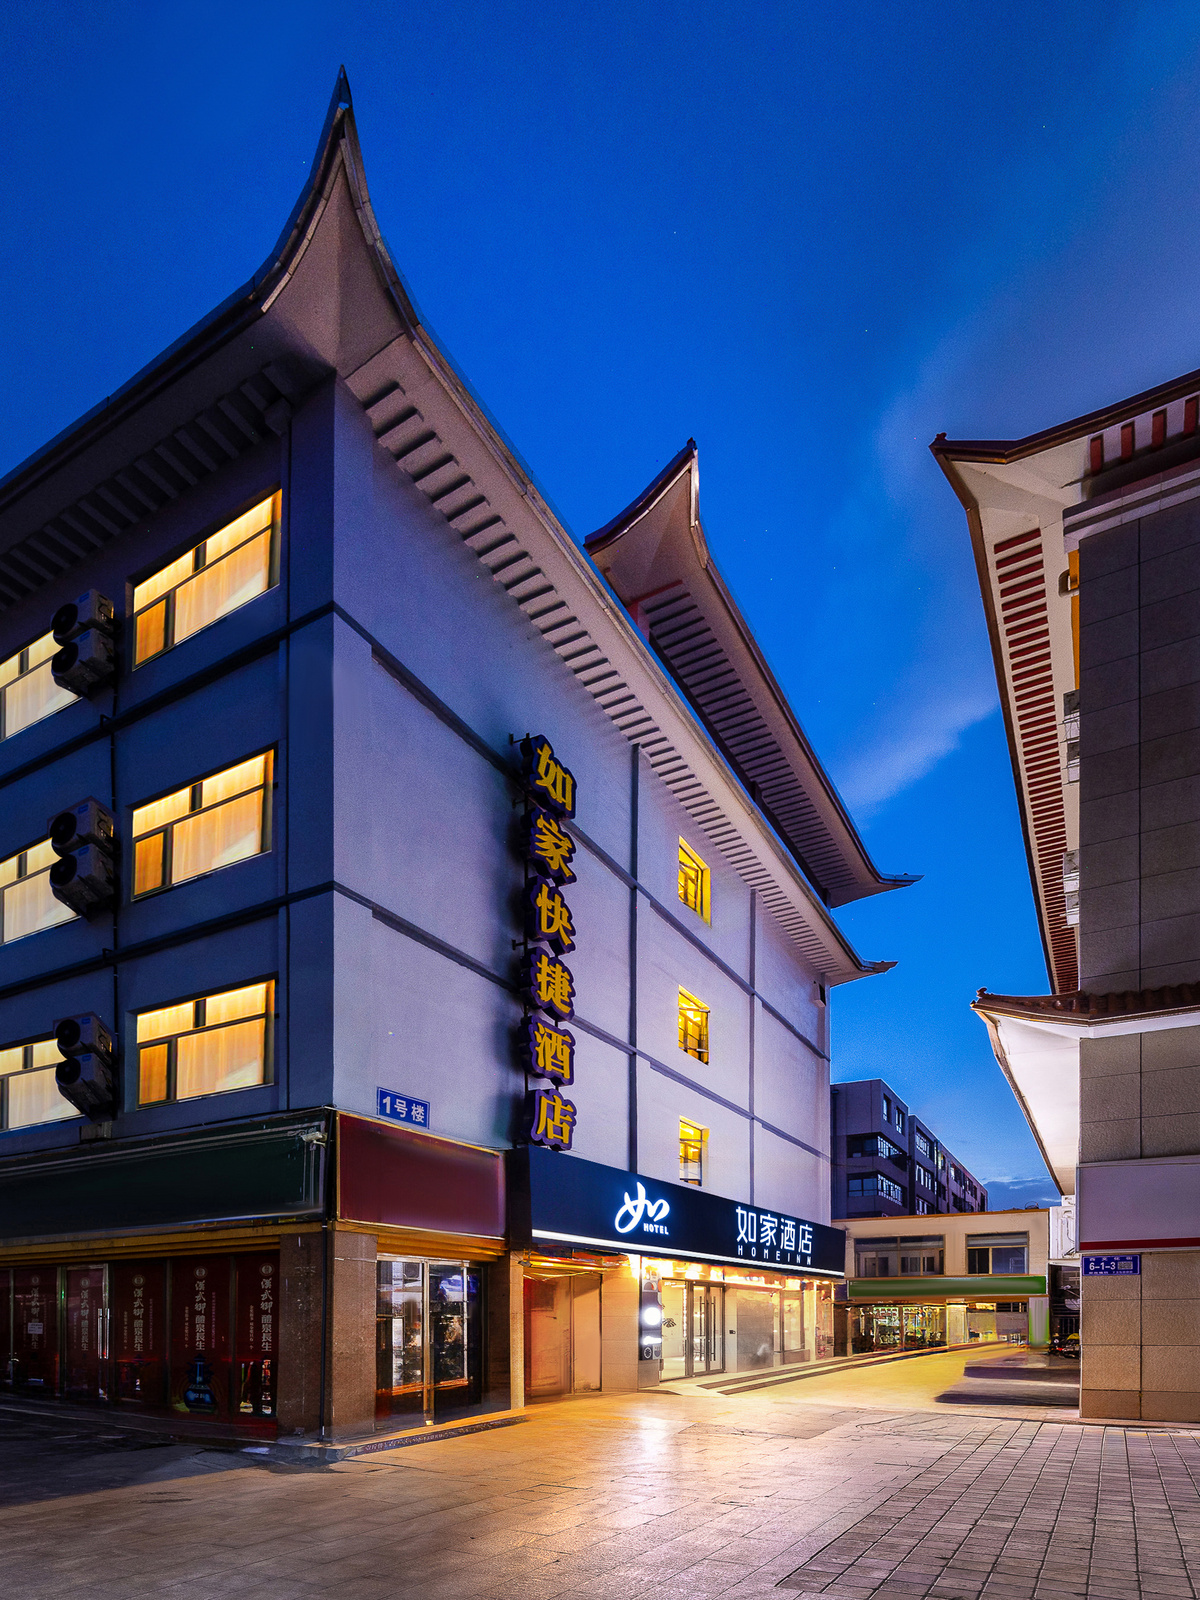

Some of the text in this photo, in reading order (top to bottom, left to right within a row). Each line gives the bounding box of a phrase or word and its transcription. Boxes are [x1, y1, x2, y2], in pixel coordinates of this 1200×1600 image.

[535, 744, 574, 1145] 如家快捷酒店
[382, 1096, 425, 1123] 1号楼
[643, 1222, 669, 1235] HOTEL
[735, 1206, 814, 1254] 如家酒店
[1089, 1262, 1116, 1270] 6-1-3
